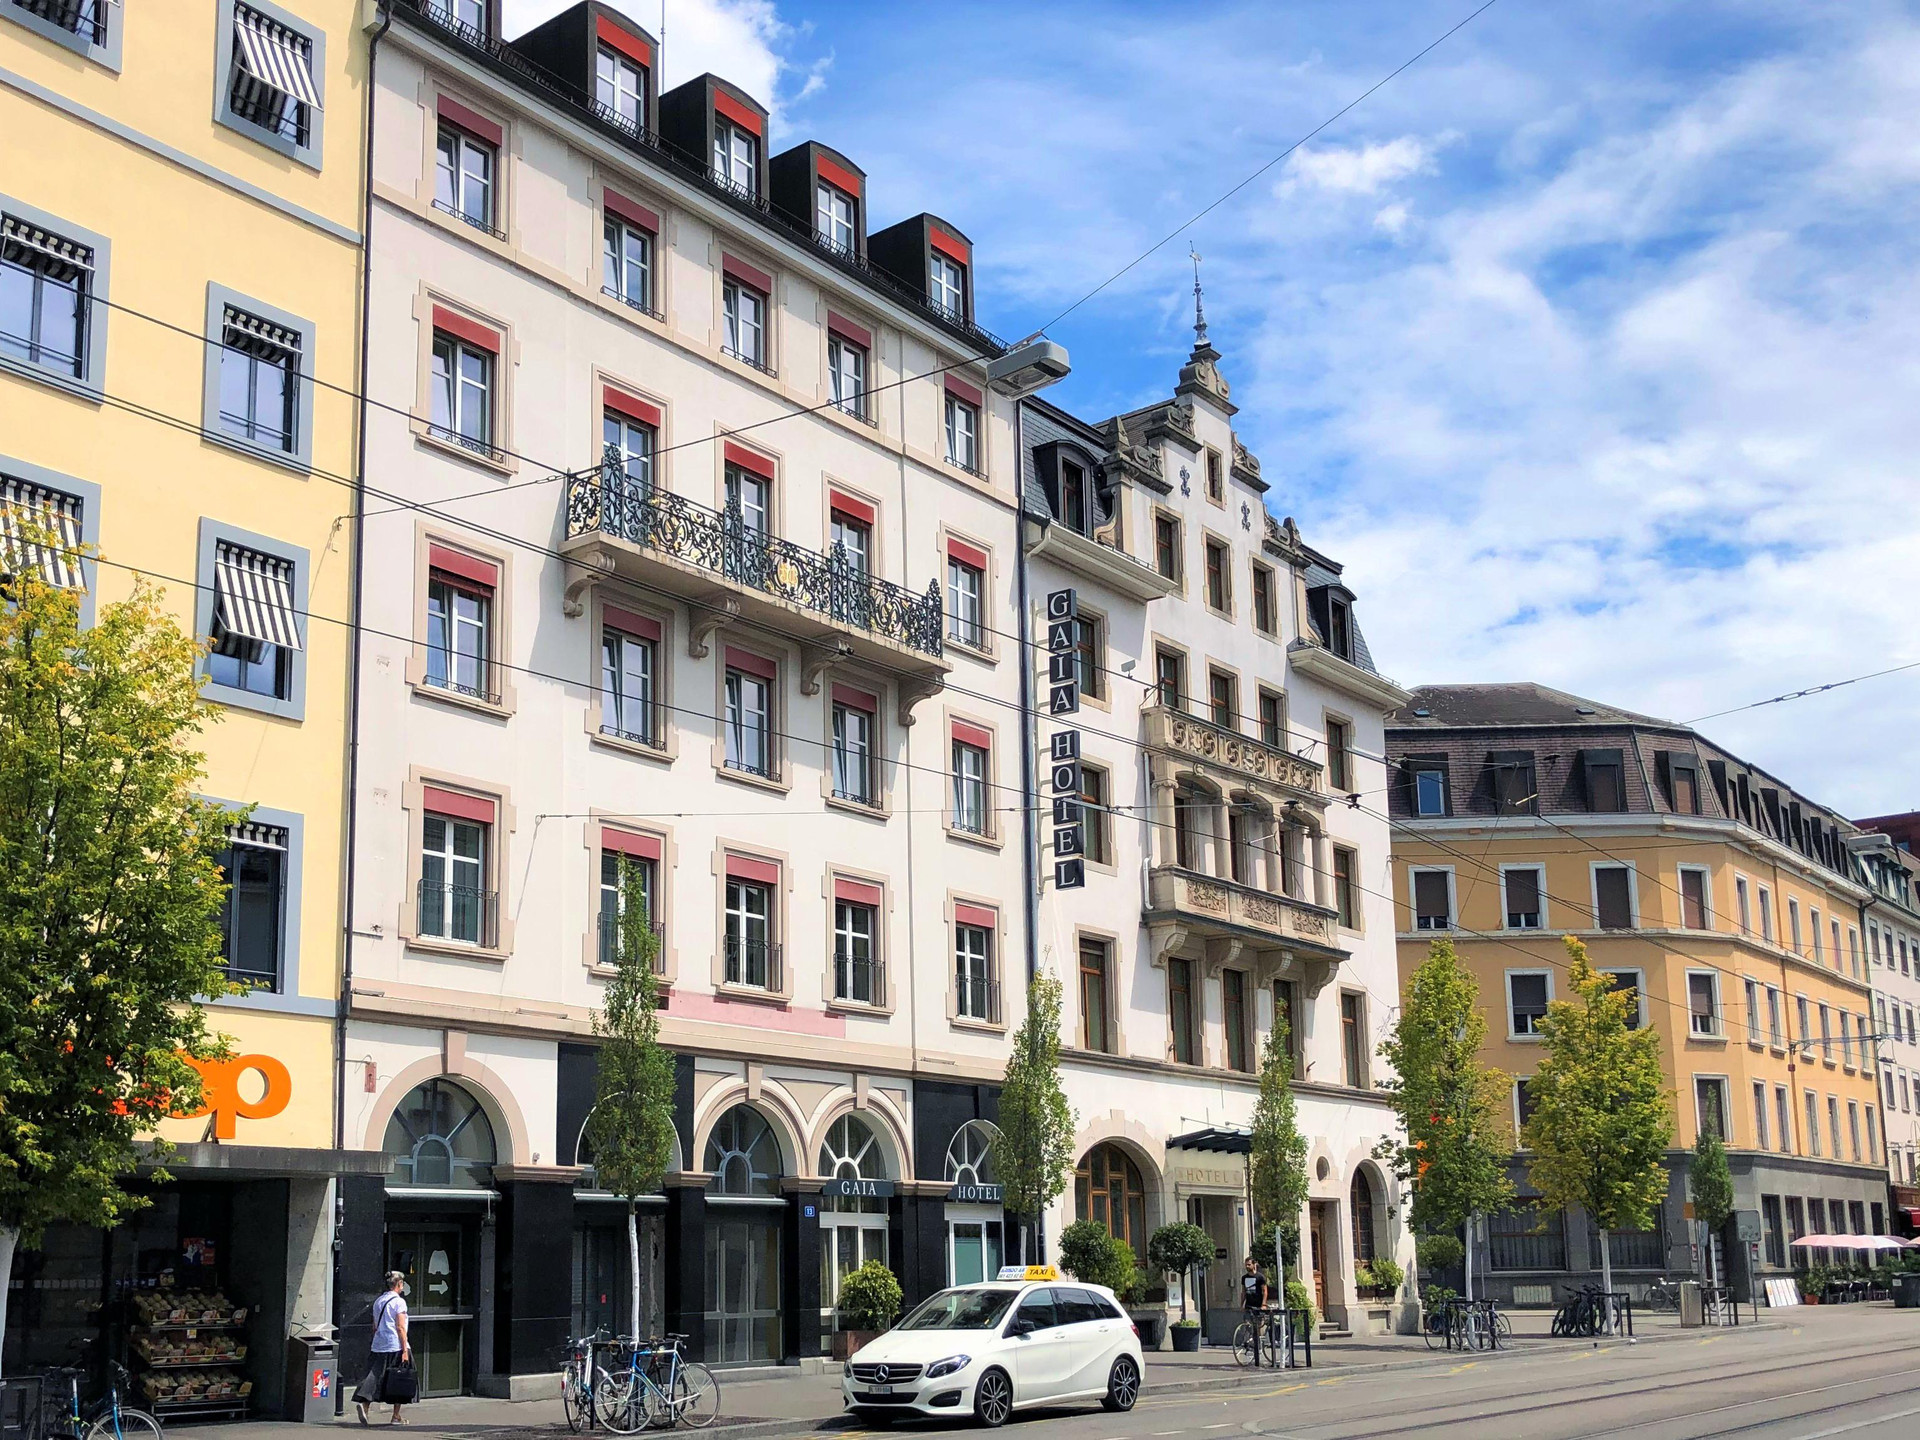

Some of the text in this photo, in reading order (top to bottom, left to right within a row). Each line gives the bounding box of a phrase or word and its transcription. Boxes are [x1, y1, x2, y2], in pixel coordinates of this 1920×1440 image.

[1050, 592, 1076, 887] GAIA HOTEL
[1186, 1168, 1229, 1184] HOTEL
[841, 1180, 877, 1196] GAIA
[957, 1186, 1000, 1200] HOTEL
[1029, 1268, 1049, 1276] TAXI
